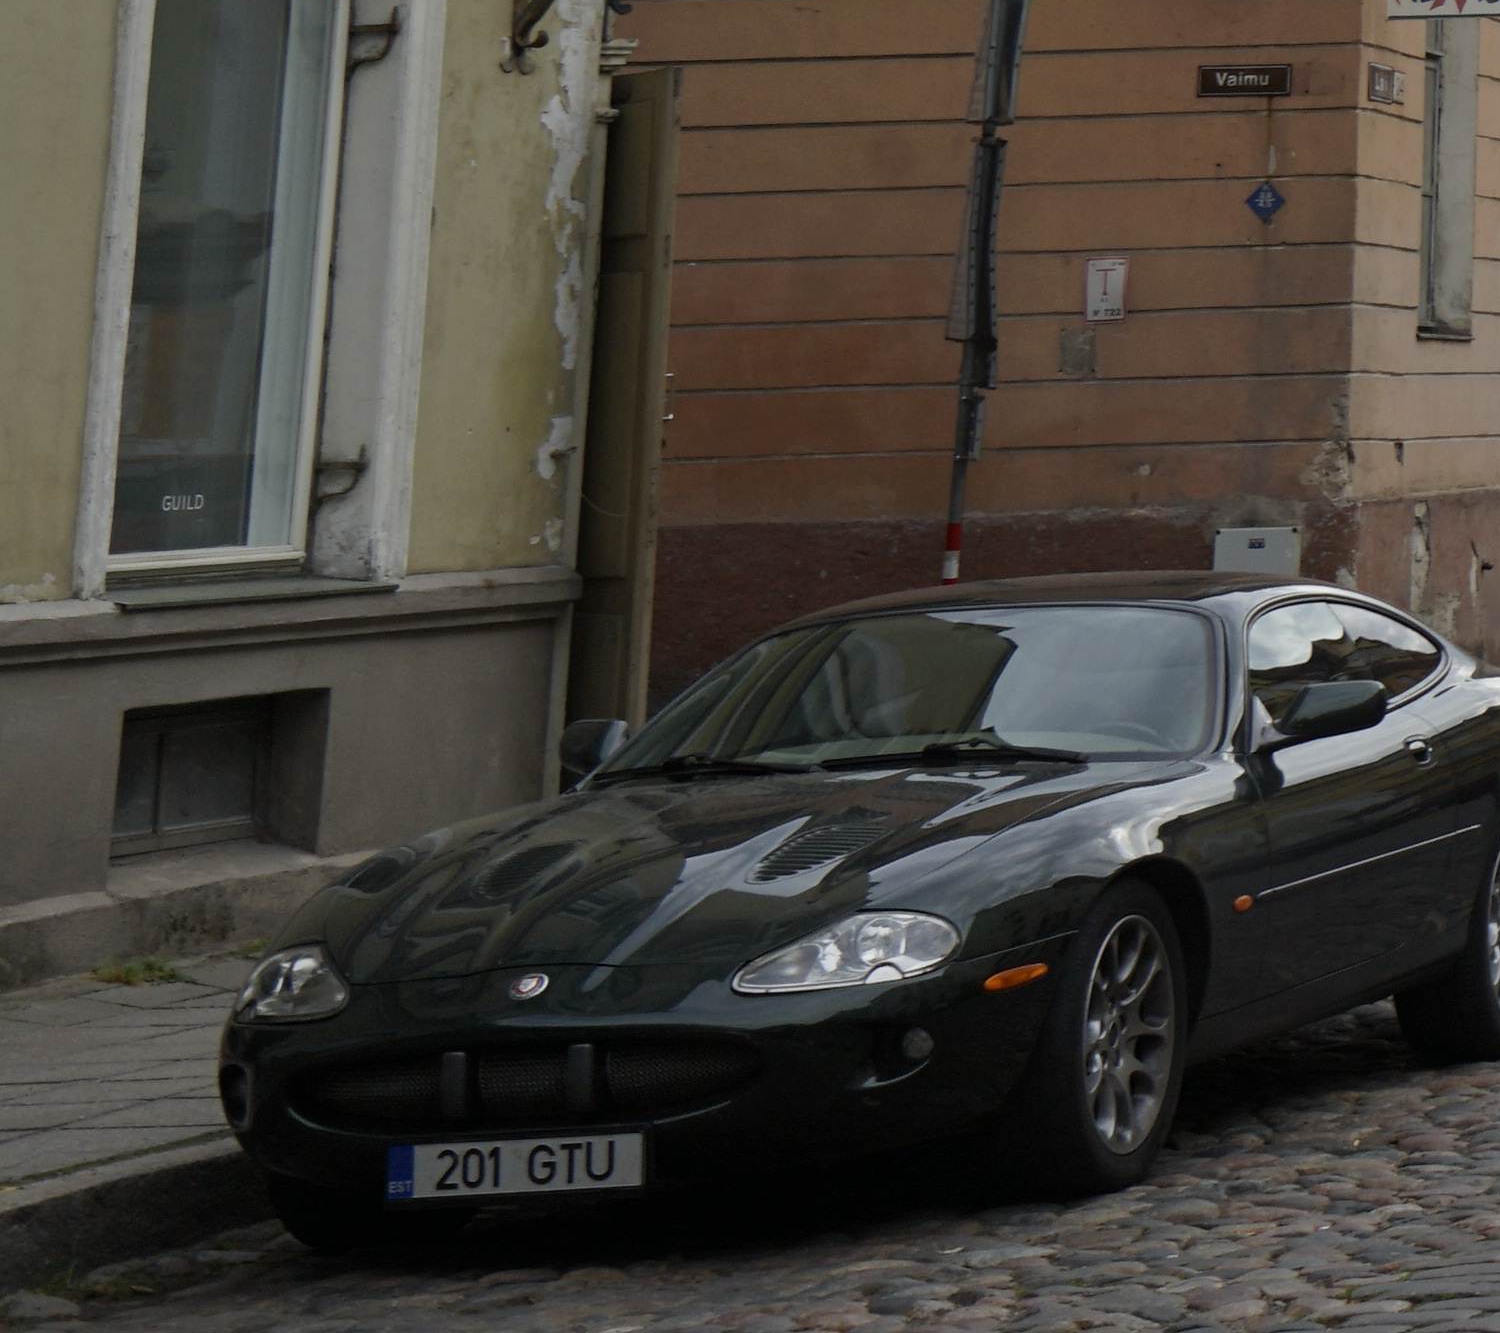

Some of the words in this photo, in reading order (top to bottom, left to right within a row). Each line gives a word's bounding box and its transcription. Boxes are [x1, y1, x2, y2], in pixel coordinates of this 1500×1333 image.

[1215, 71, 1269, 87] Vaimu
[162, 494, 204, 511] GUILD
[435, 1146, 500, 1191] 201
[528, 1140, 614, 1184] GTU
